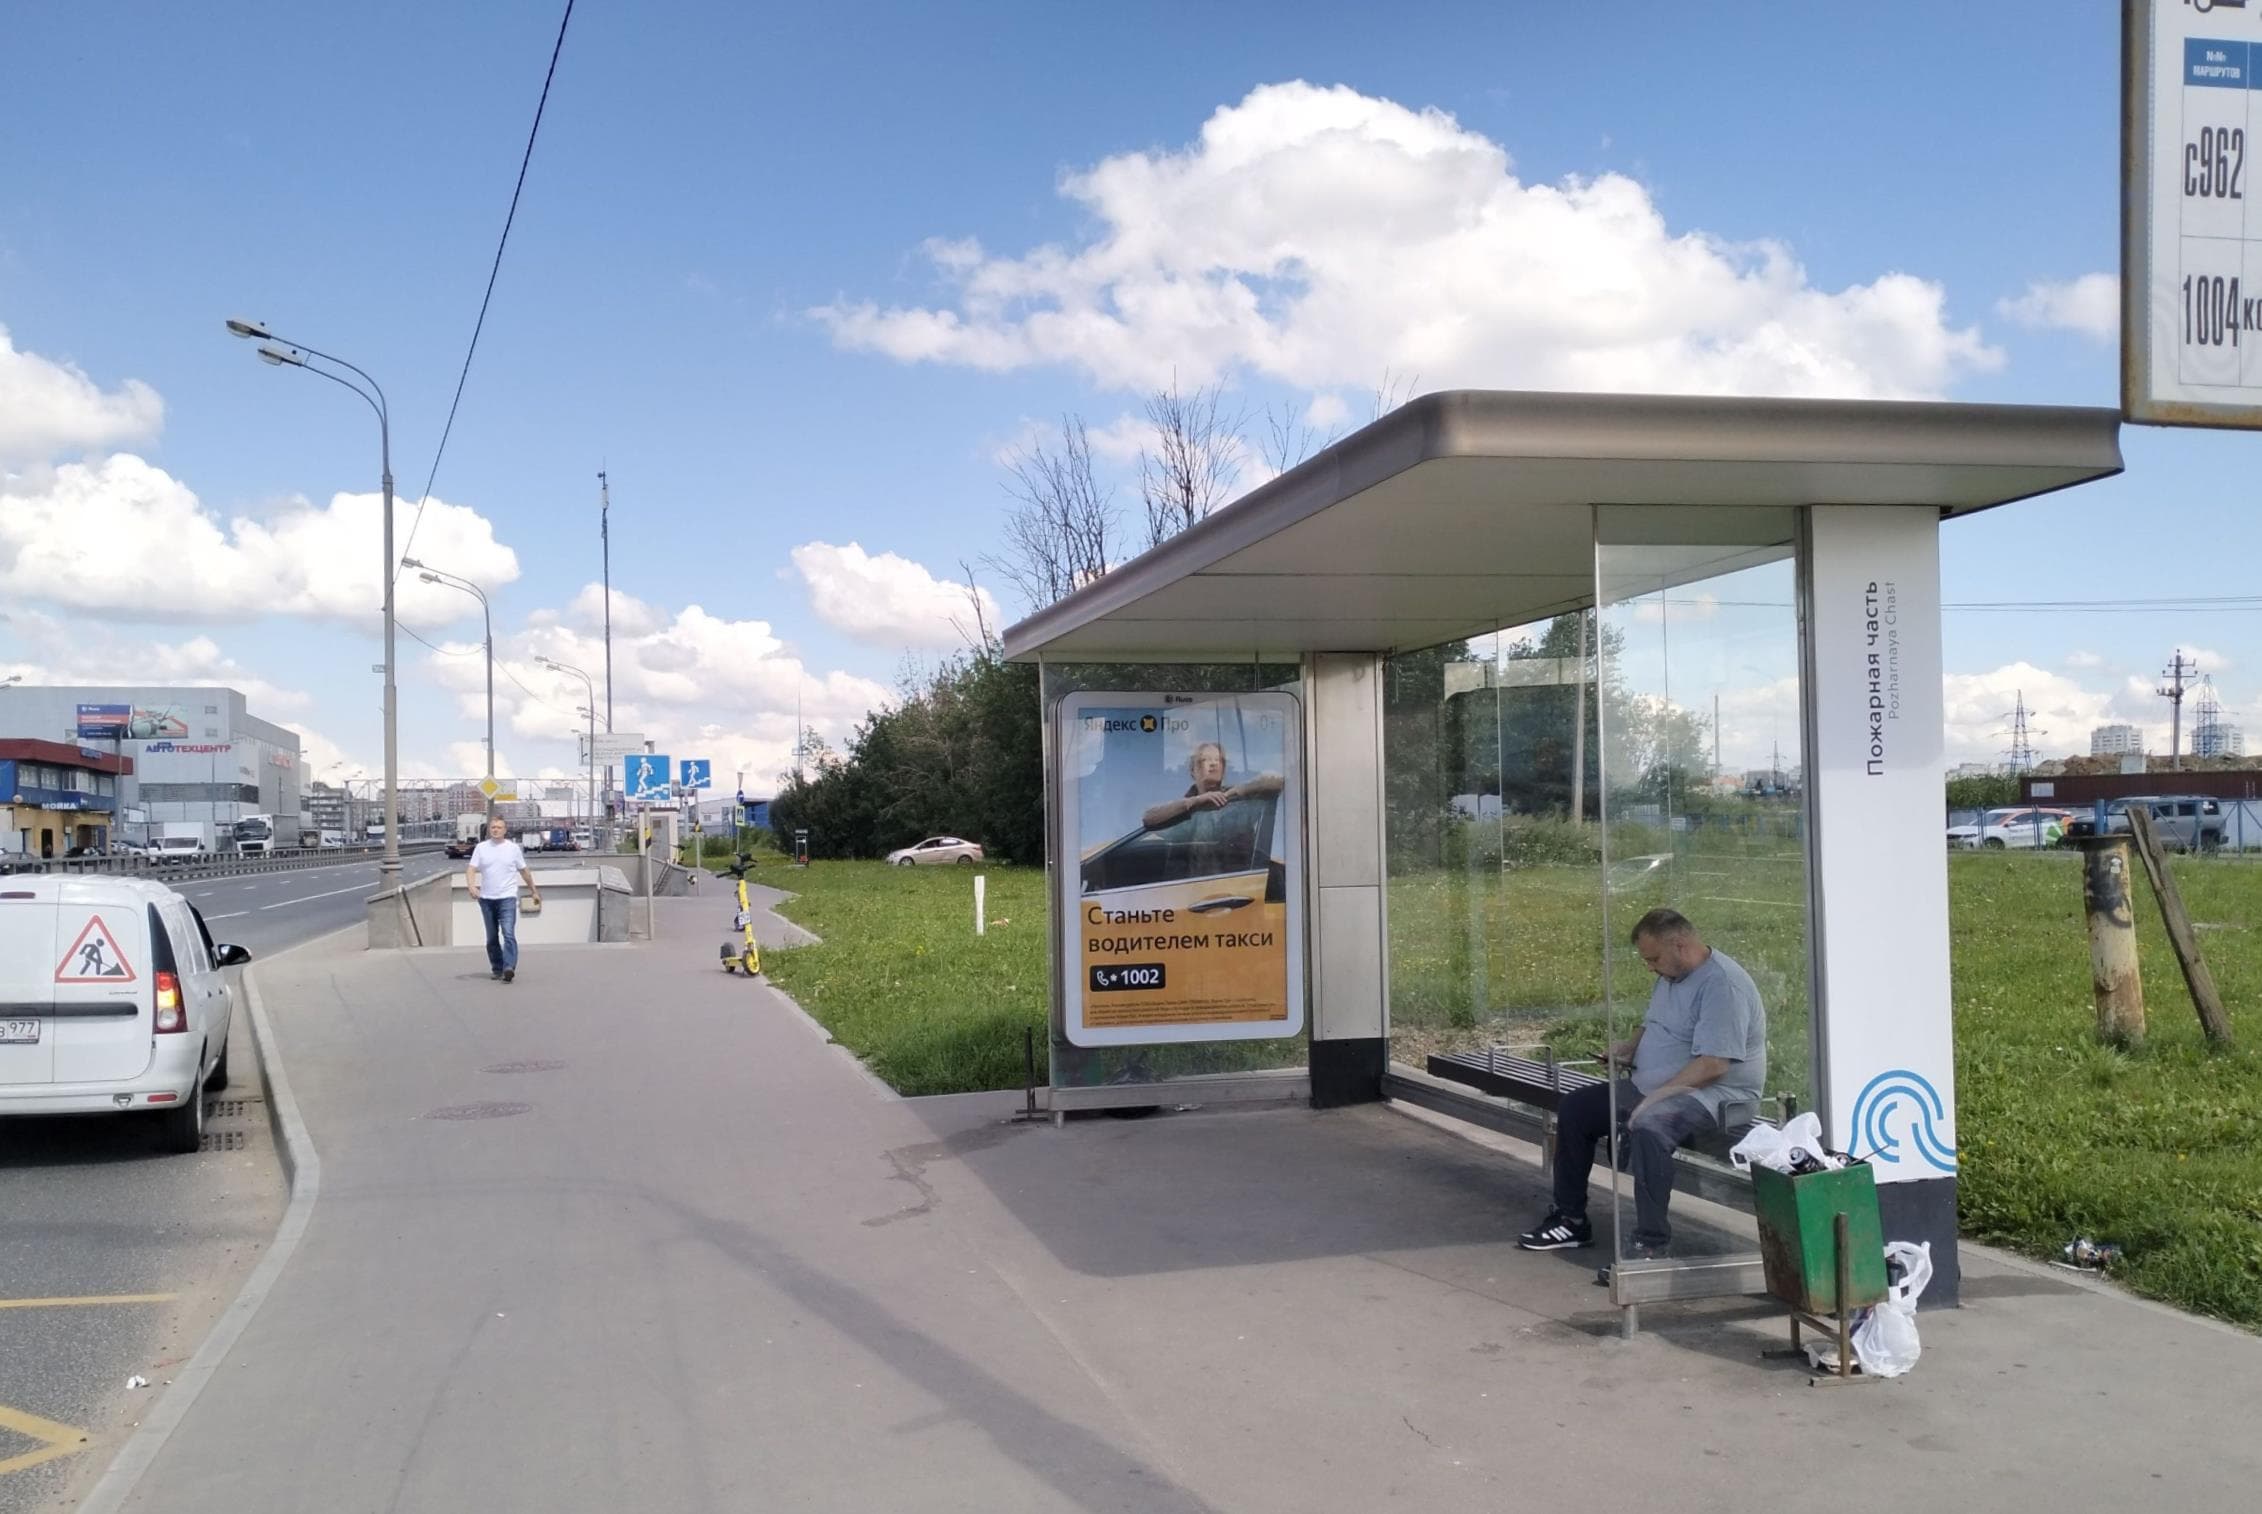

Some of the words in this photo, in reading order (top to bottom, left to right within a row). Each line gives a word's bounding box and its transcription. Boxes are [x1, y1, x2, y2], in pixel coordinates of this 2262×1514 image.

[2184, 126, 2244, 199] с962
[1866, 581, 1880, 647] часть
[1885, 581, 1897, 625] Chast
[1887, 630, 1900, 720] Pozharnaya
[1084, 716, 1137, 733] Яндекс
[1161, 717, 1190, 734] Про
[1867, 652, 1885, 776] Пожарная
[1087, 906, 1175, 925] Станьте
[1088, 934, 1209, 954] водителем
[1215, 932, 1273, 948] такси
[9, 1021, 35, 1034] 977
